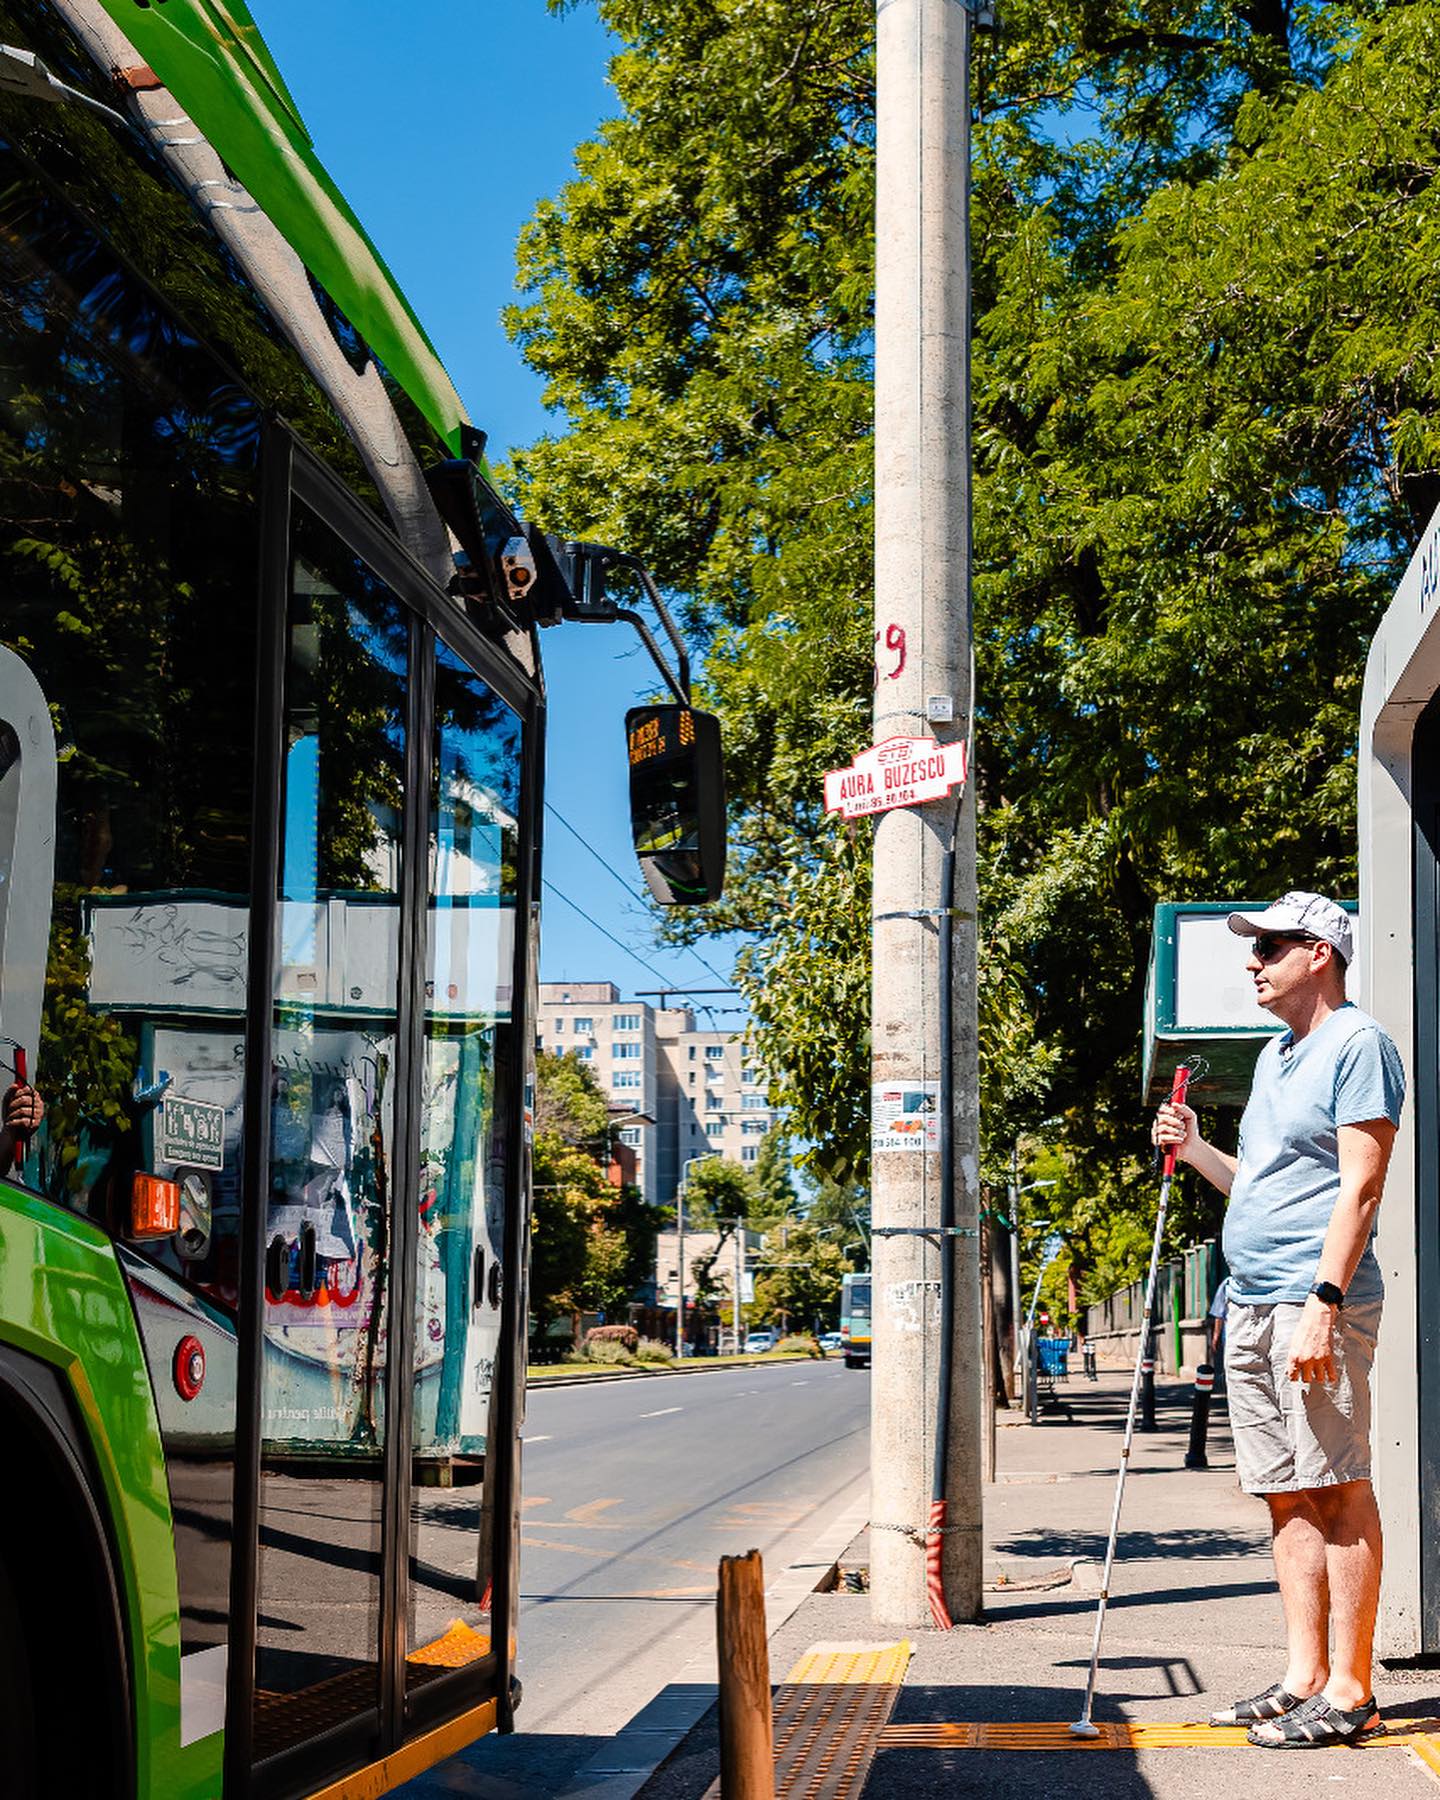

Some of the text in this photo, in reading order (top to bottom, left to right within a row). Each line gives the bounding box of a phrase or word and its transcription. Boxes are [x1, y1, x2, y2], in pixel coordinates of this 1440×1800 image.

[875, 623, 906, 680] 9
[840, 754, 945, 800] AURA BUZESCU
